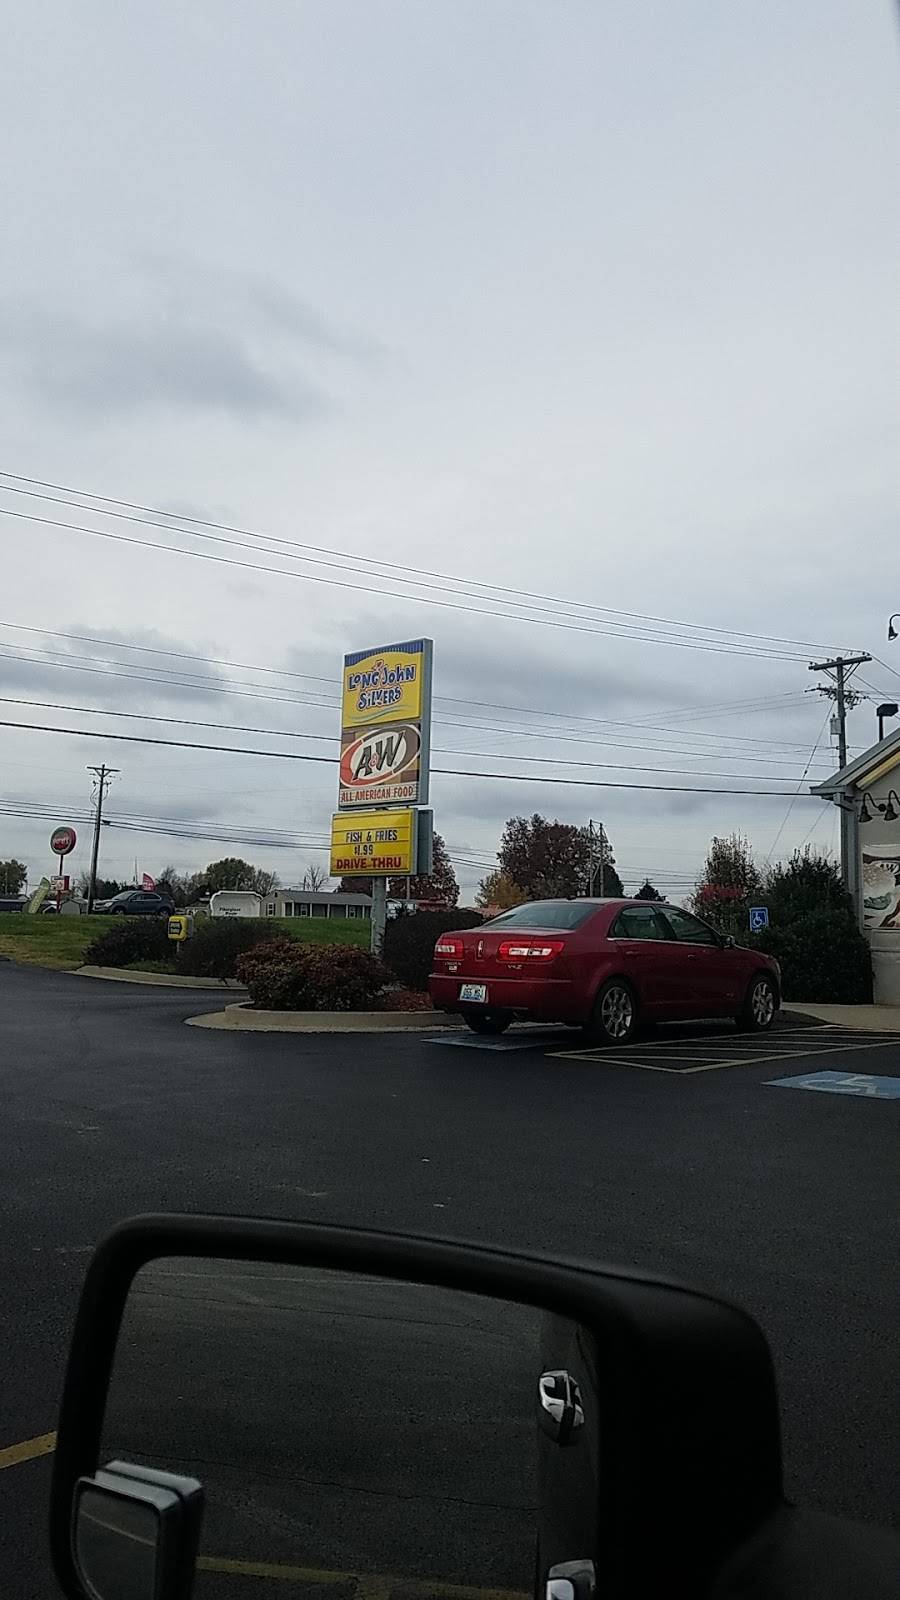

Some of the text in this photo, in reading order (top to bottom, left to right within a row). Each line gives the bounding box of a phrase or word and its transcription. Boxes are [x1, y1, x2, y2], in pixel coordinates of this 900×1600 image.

[352, 730, 406, 781] A&W
[341, 785, 414, 802] ALL AMERICAN FOOD
[345, 829, 398, 843] FISH & FRIES
[336, 856, 402, 870] DRIVE THRU
